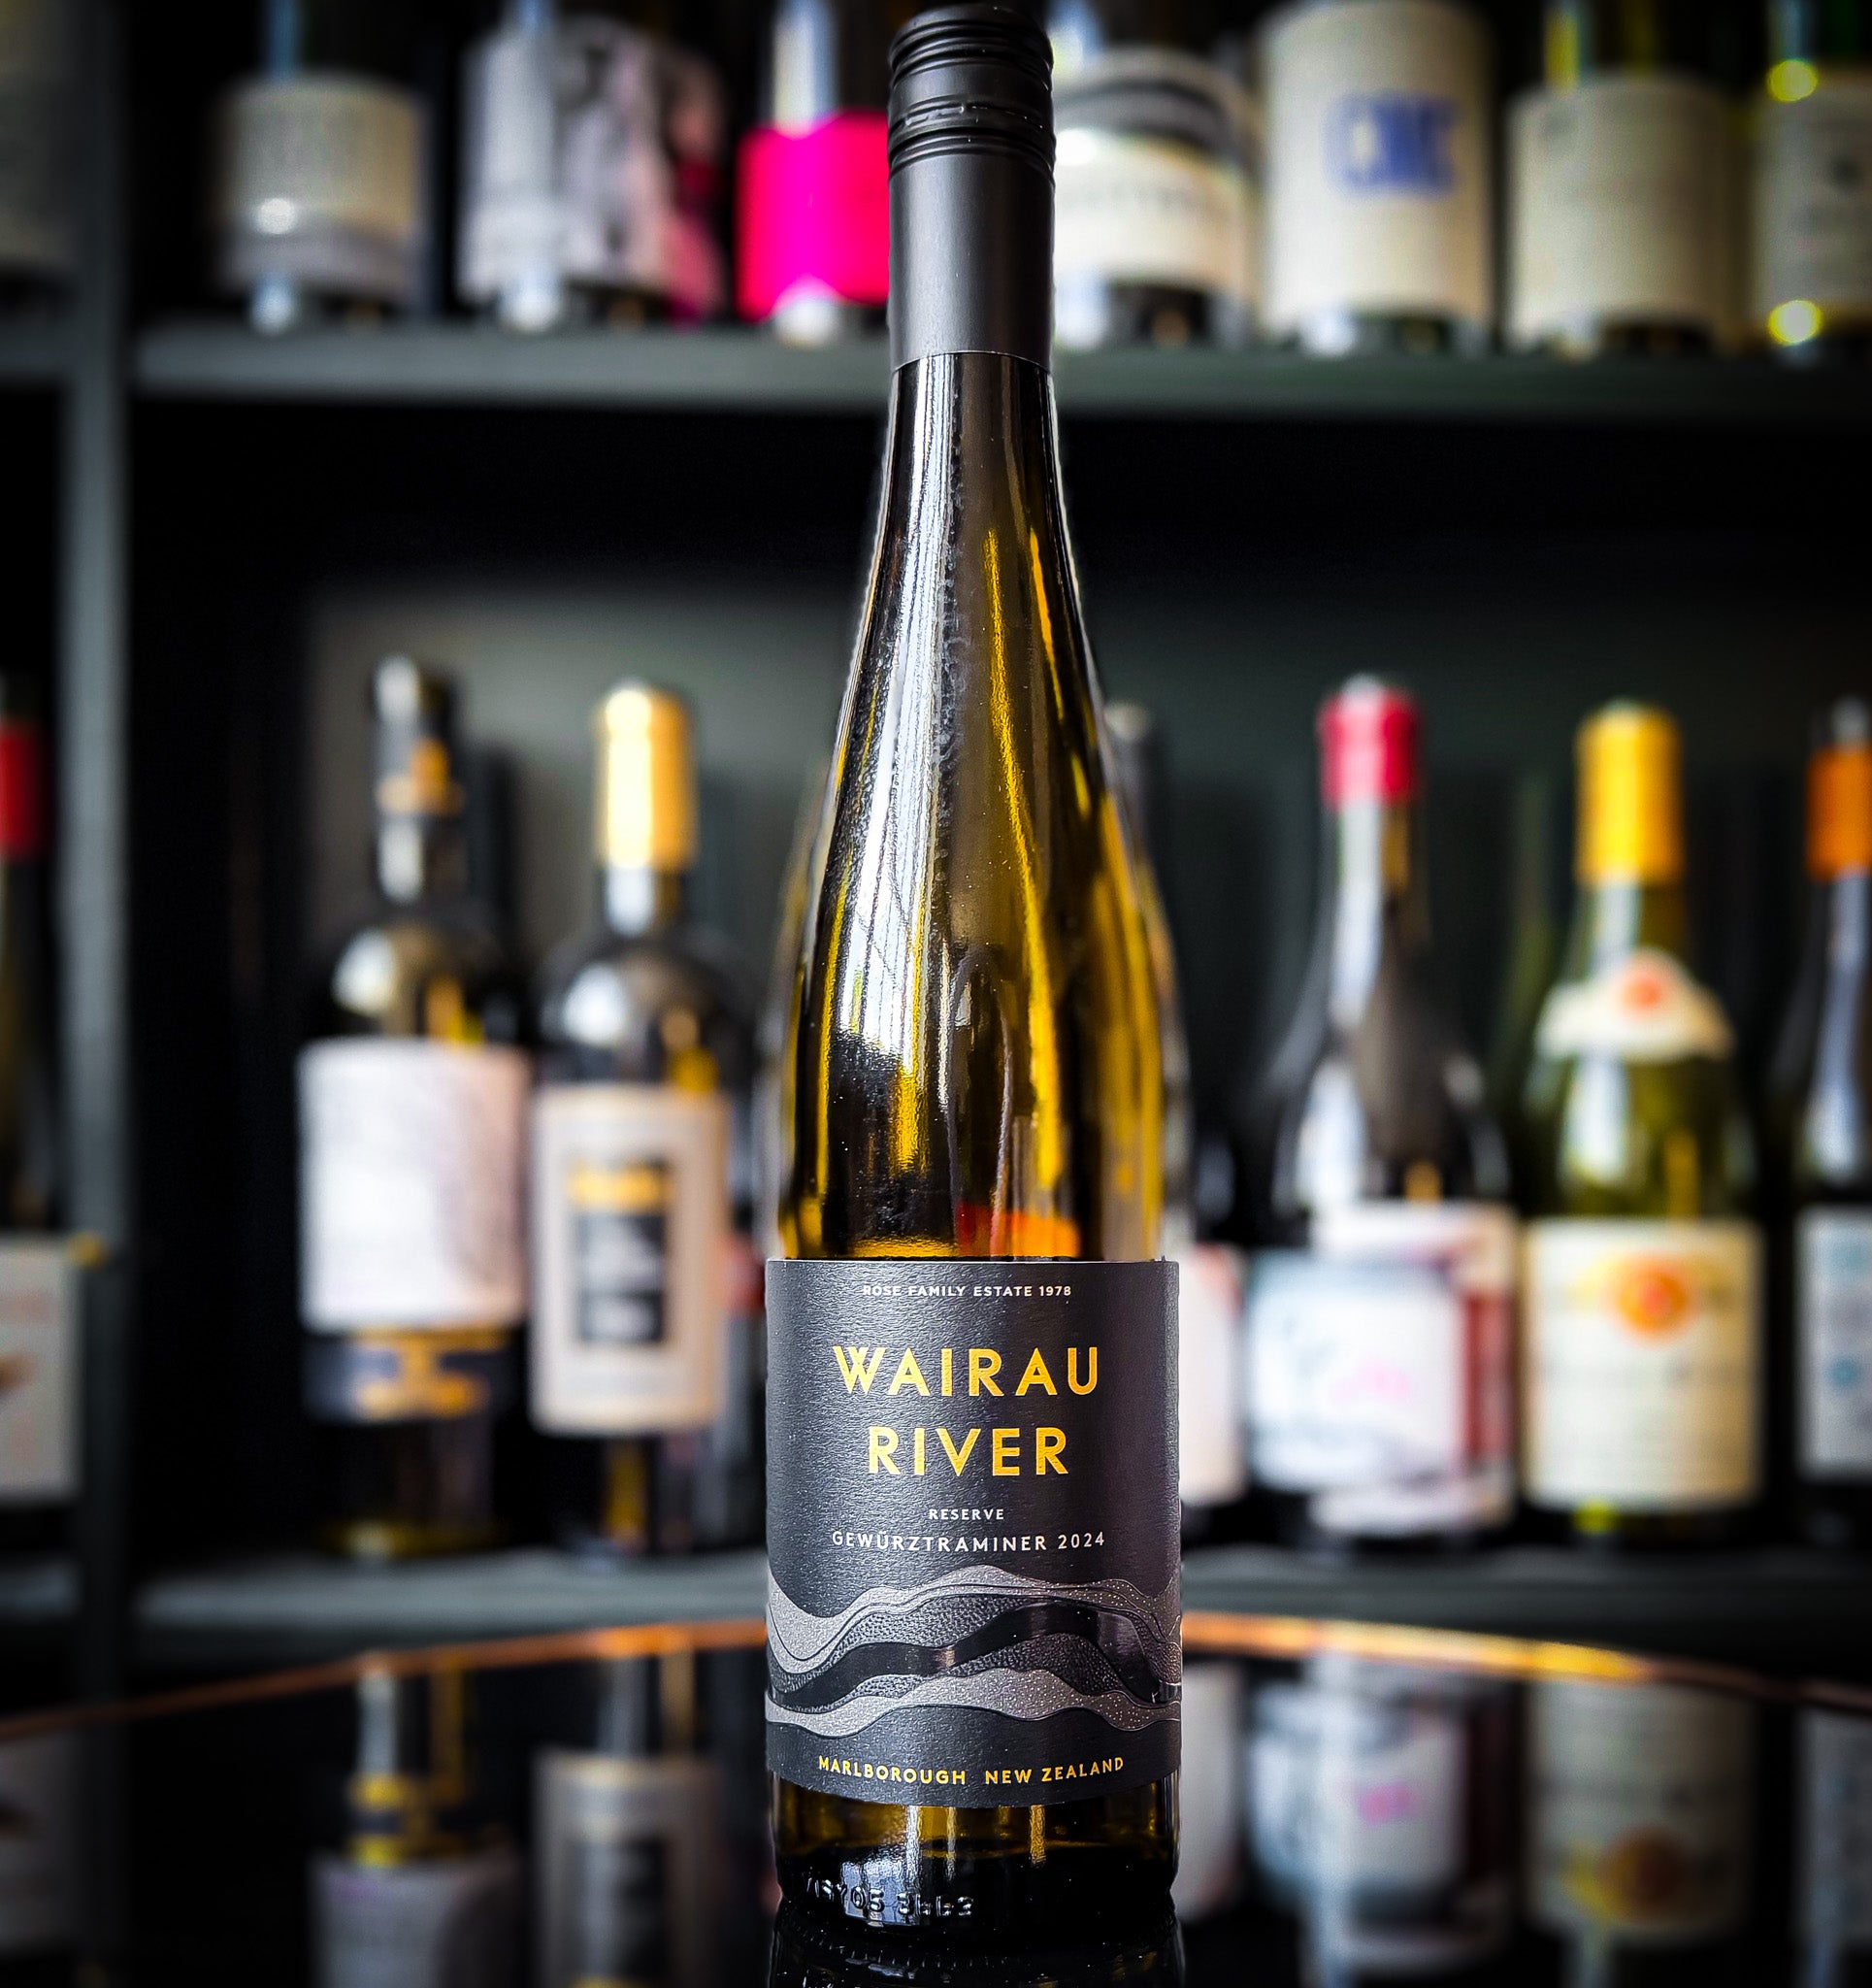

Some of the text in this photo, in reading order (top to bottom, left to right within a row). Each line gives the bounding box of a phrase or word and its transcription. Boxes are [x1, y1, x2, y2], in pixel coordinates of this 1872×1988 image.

[862, 1285, 1072, 1297] ROSE FAMILY ESTATE 1978
[833, 1345, 1099, 1397] WAIRAU
[869, 1426, 1069, 1477] RIVER
[928, 1508, 1004, 1520] RESERVE
[832, 1530, 1105, 1552] GEWÜRZTRAMINER 2024
[818, 1755, 1124, 1785] MARLBOROUGH NEW ZEALAND
